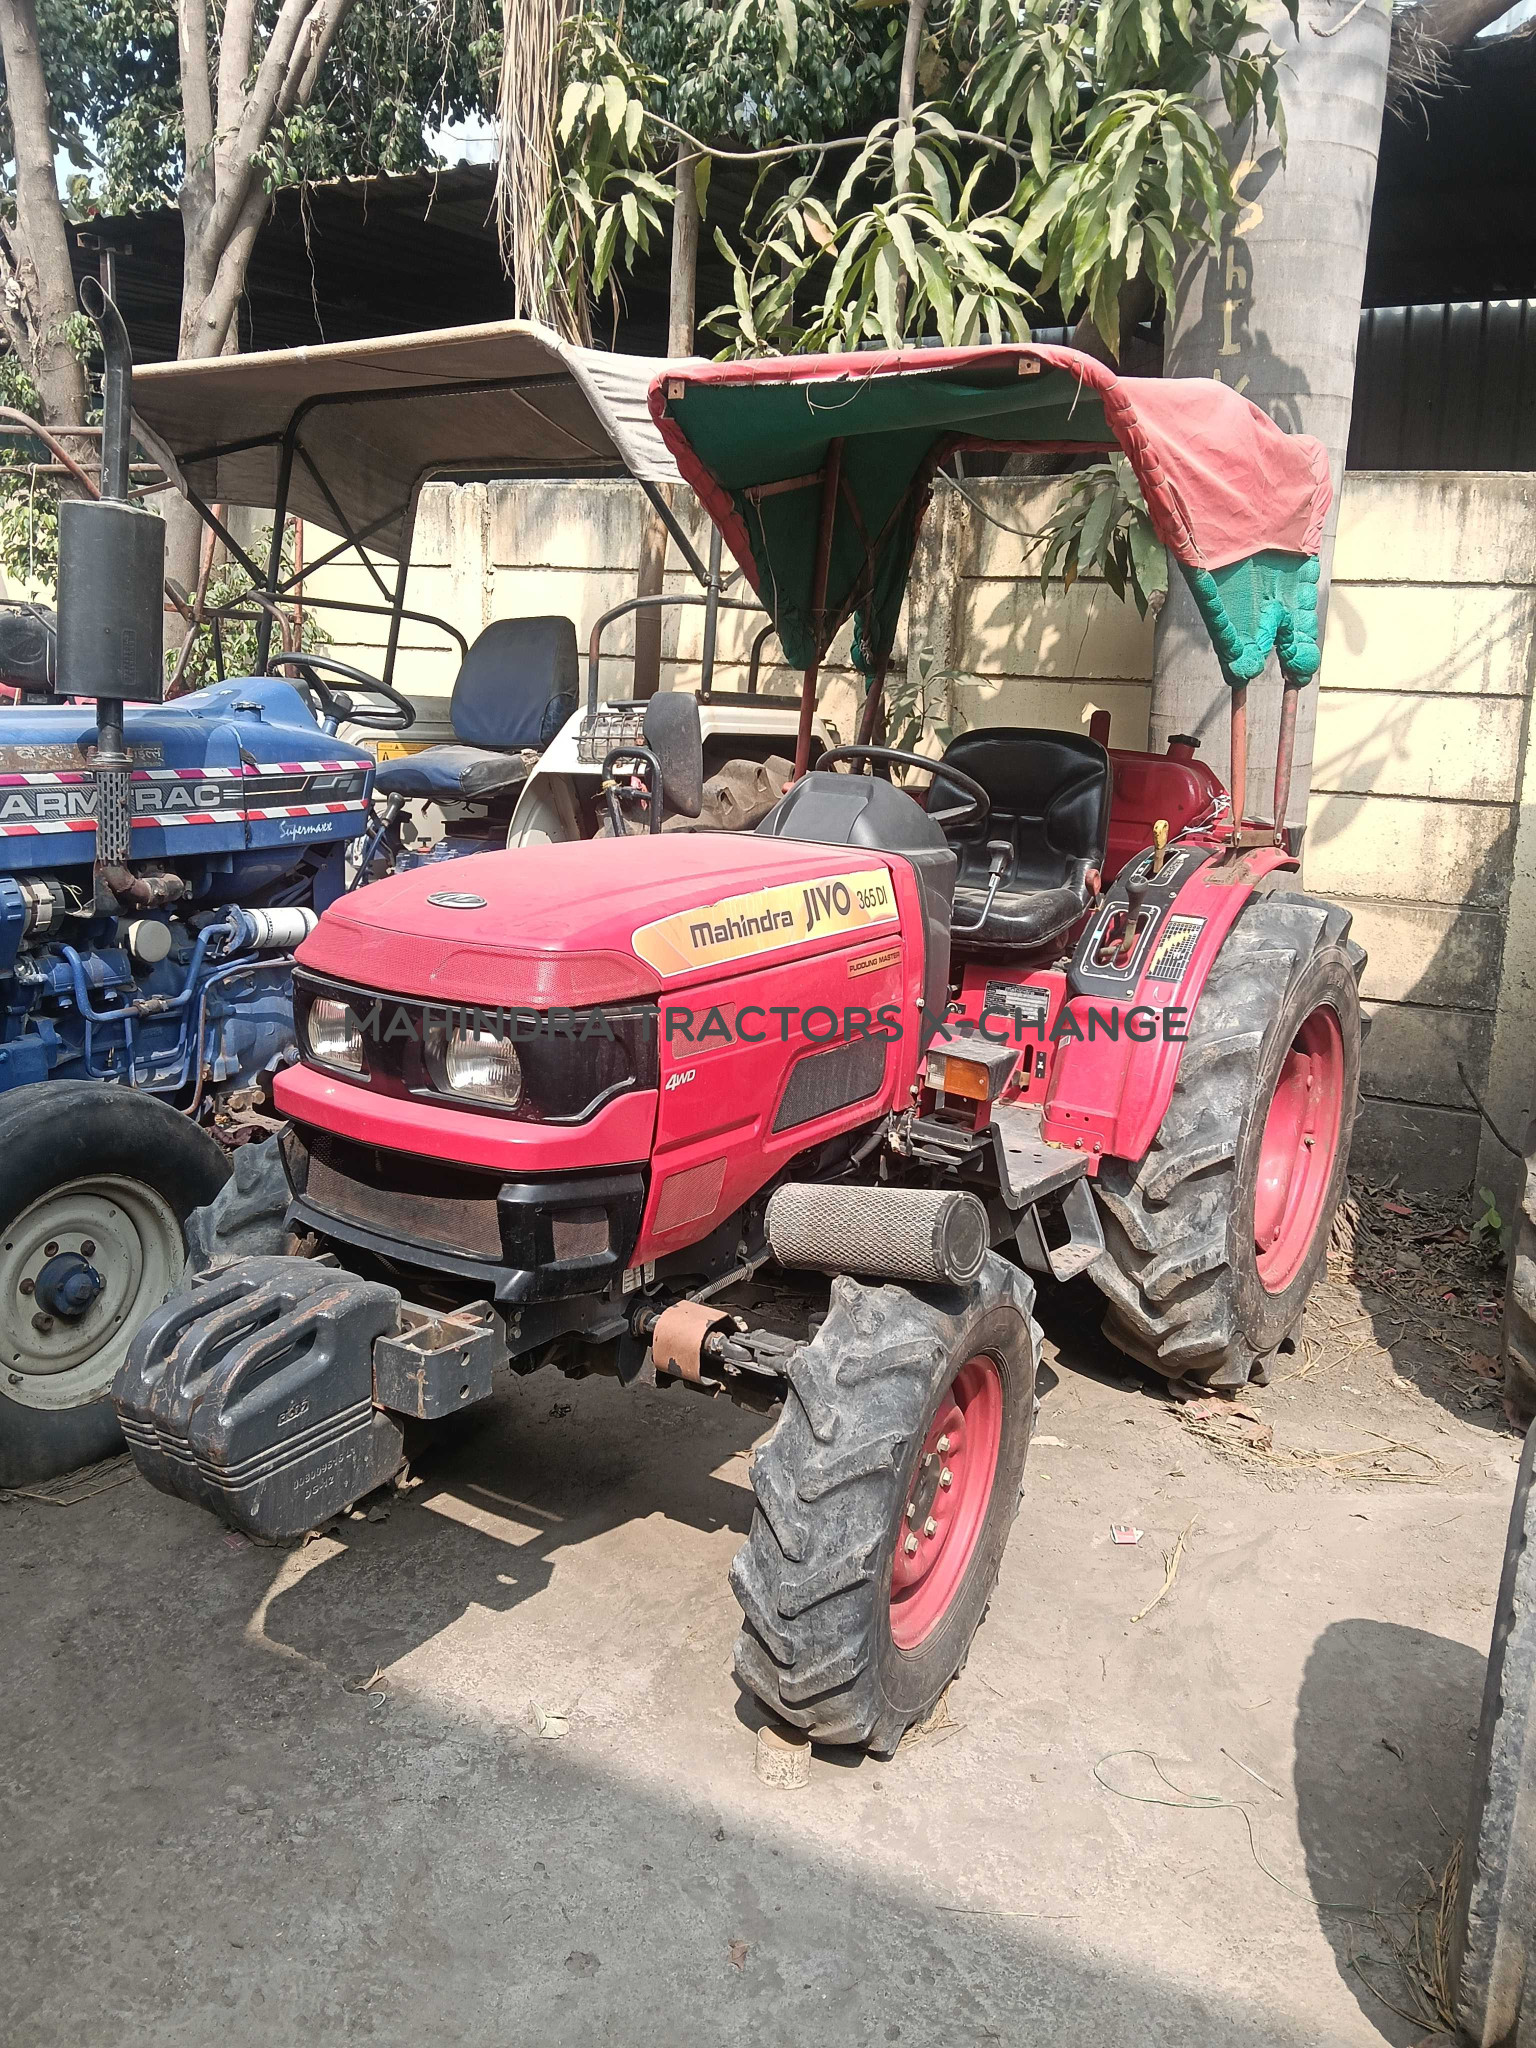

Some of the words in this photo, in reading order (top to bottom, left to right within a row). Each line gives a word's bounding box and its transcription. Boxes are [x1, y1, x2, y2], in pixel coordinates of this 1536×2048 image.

[690, 908, 794, 948] Mahindra
[803, 881, 851, 932] JIVO
[849, 958, 878, 973] PUDDLING
[878, 951, 900, 964] MASTER
[665, 1069, 696, 1091] 4WD
